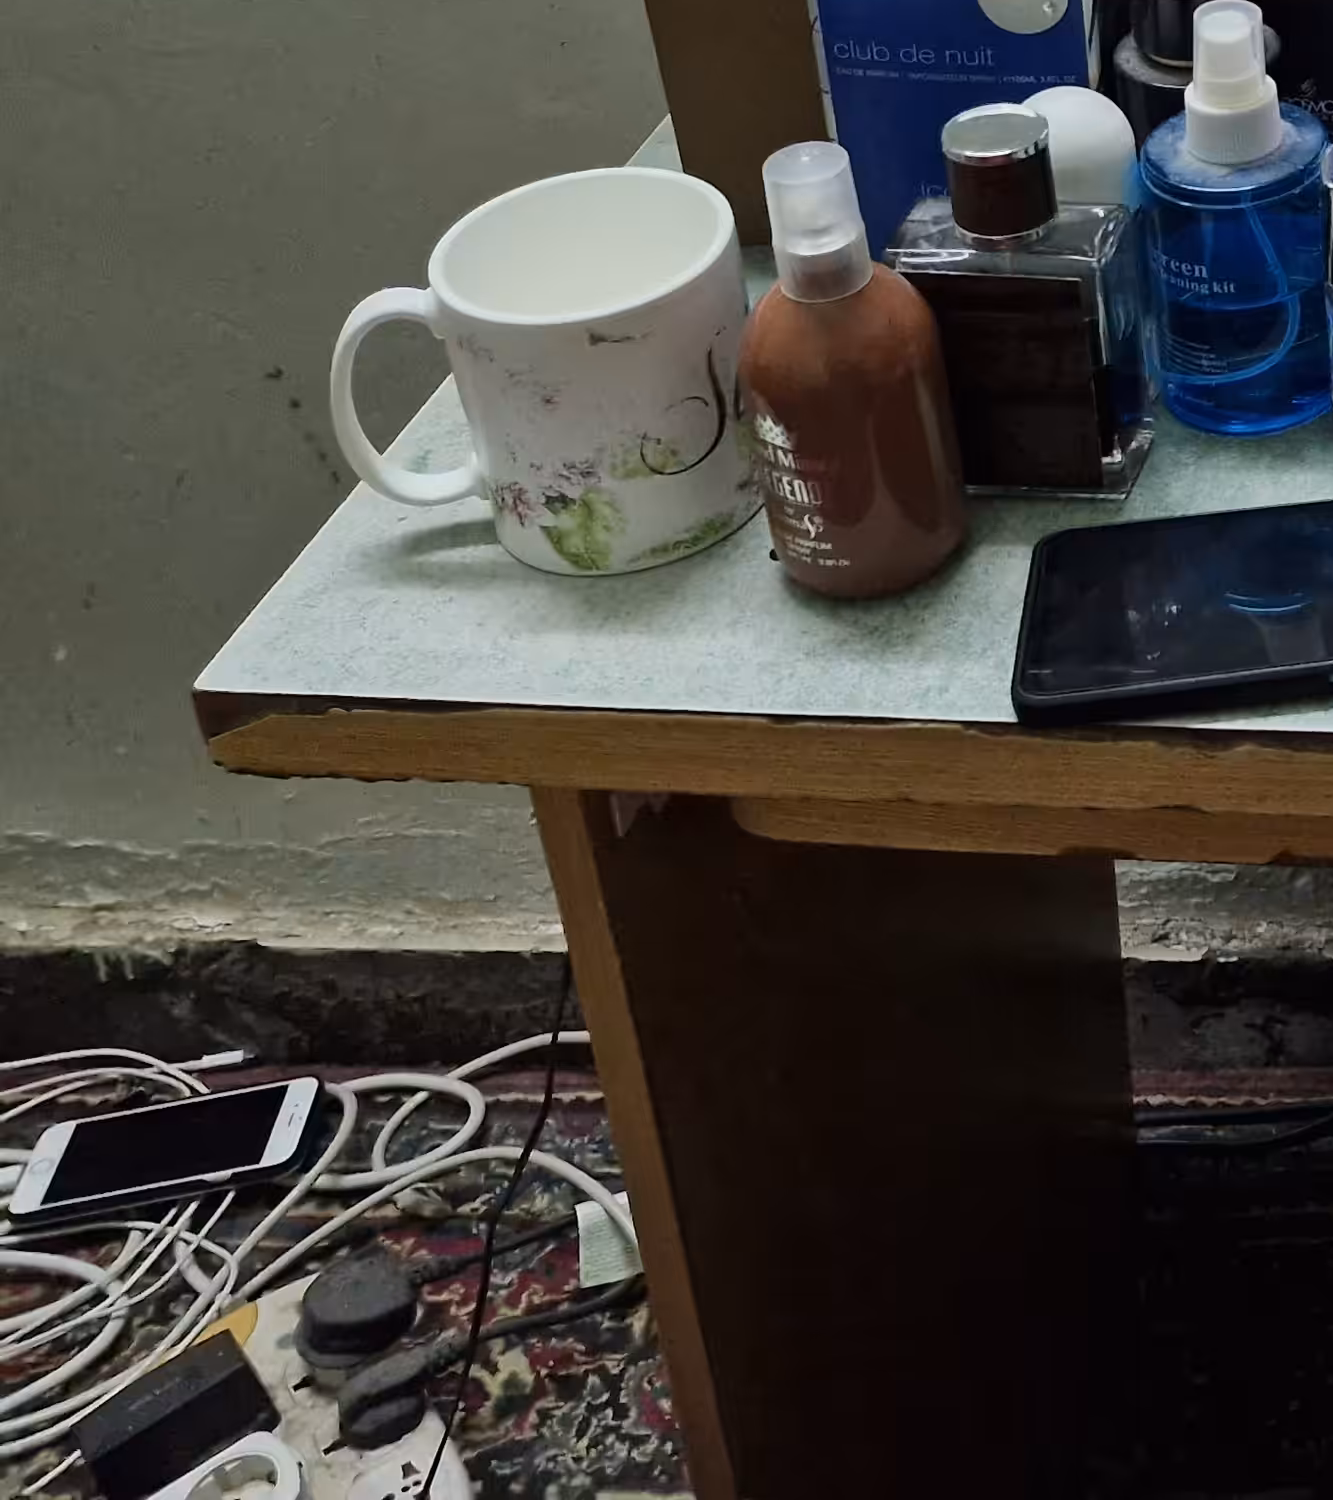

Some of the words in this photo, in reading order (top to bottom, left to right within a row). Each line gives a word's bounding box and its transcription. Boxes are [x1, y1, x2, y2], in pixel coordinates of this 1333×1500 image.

[833, 40, 890, 62] club
[899, 43, 936, 64] de
[945, 46, 995, 66] nuit
[1213, 281, 1236, 293] kit
